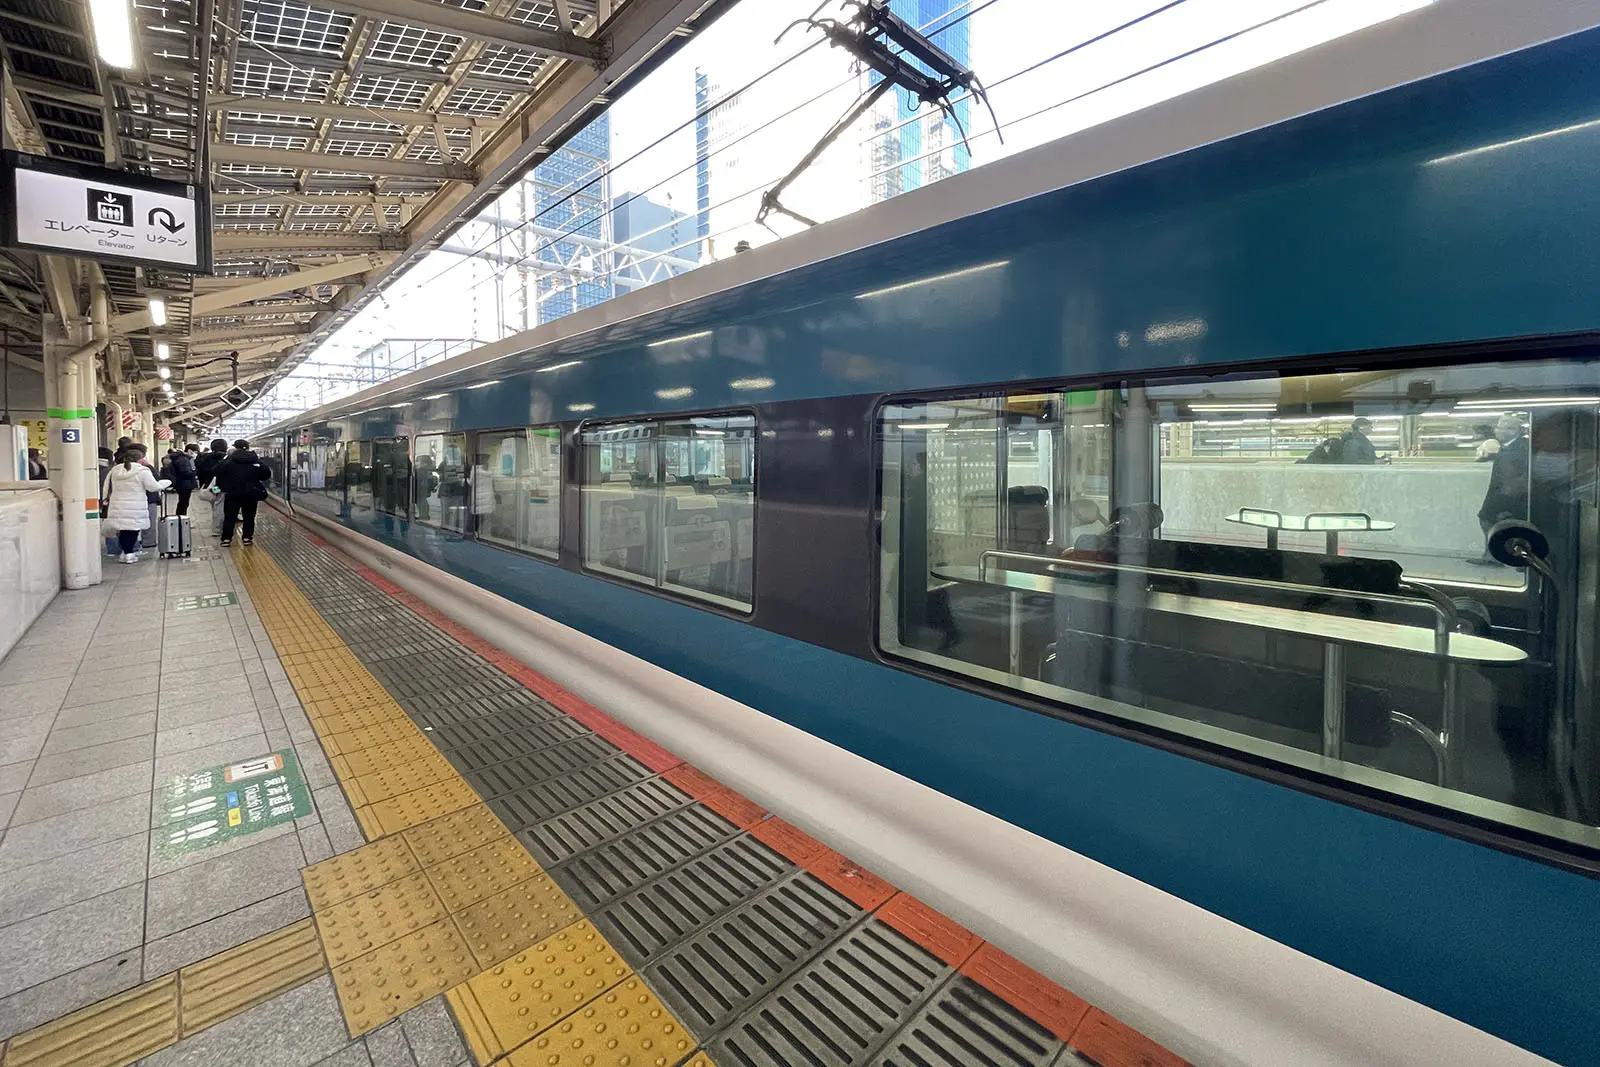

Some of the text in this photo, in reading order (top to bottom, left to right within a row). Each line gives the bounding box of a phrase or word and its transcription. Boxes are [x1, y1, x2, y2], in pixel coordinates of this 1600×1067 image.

[44, 219, 135, 239] エレベーター
[98, 239, 135, 250] Elevator
[146, 233, 188, 247] Uターン
[66, 431, 76, 442] 3
